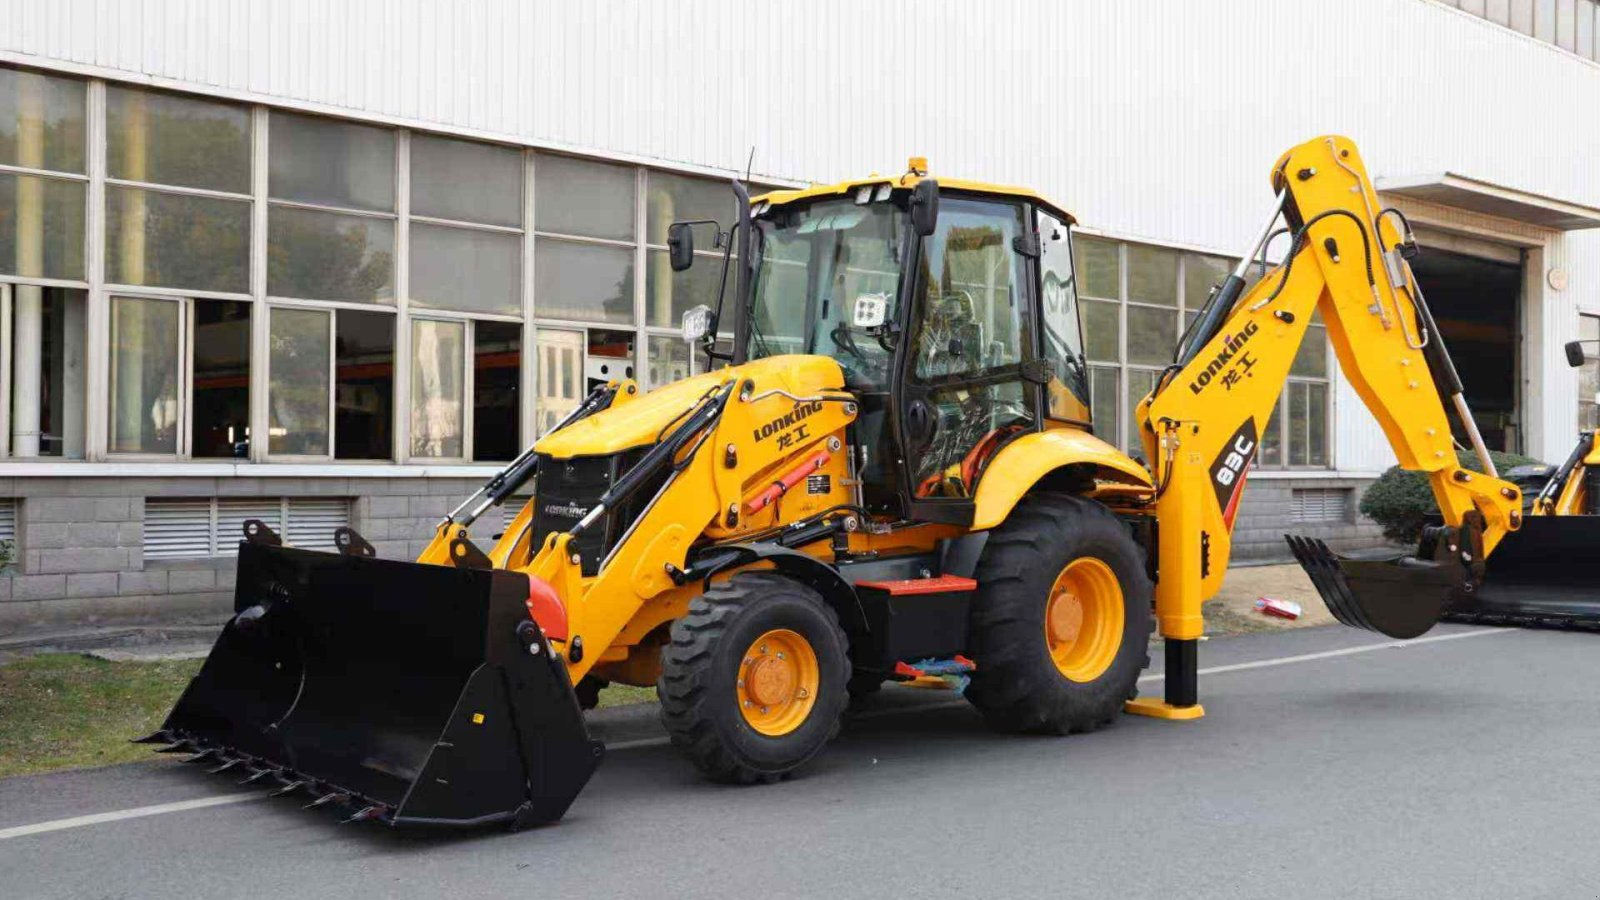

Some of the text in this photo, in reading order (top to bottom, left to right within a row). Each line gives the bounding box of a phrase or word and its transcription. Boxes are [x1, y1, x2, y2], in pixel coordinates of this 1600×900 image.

[1220, 351, 1258, 391] 龙工
[776, 424, 810, 451] 龙工
[1216, 435, 1253, 486] 83C
